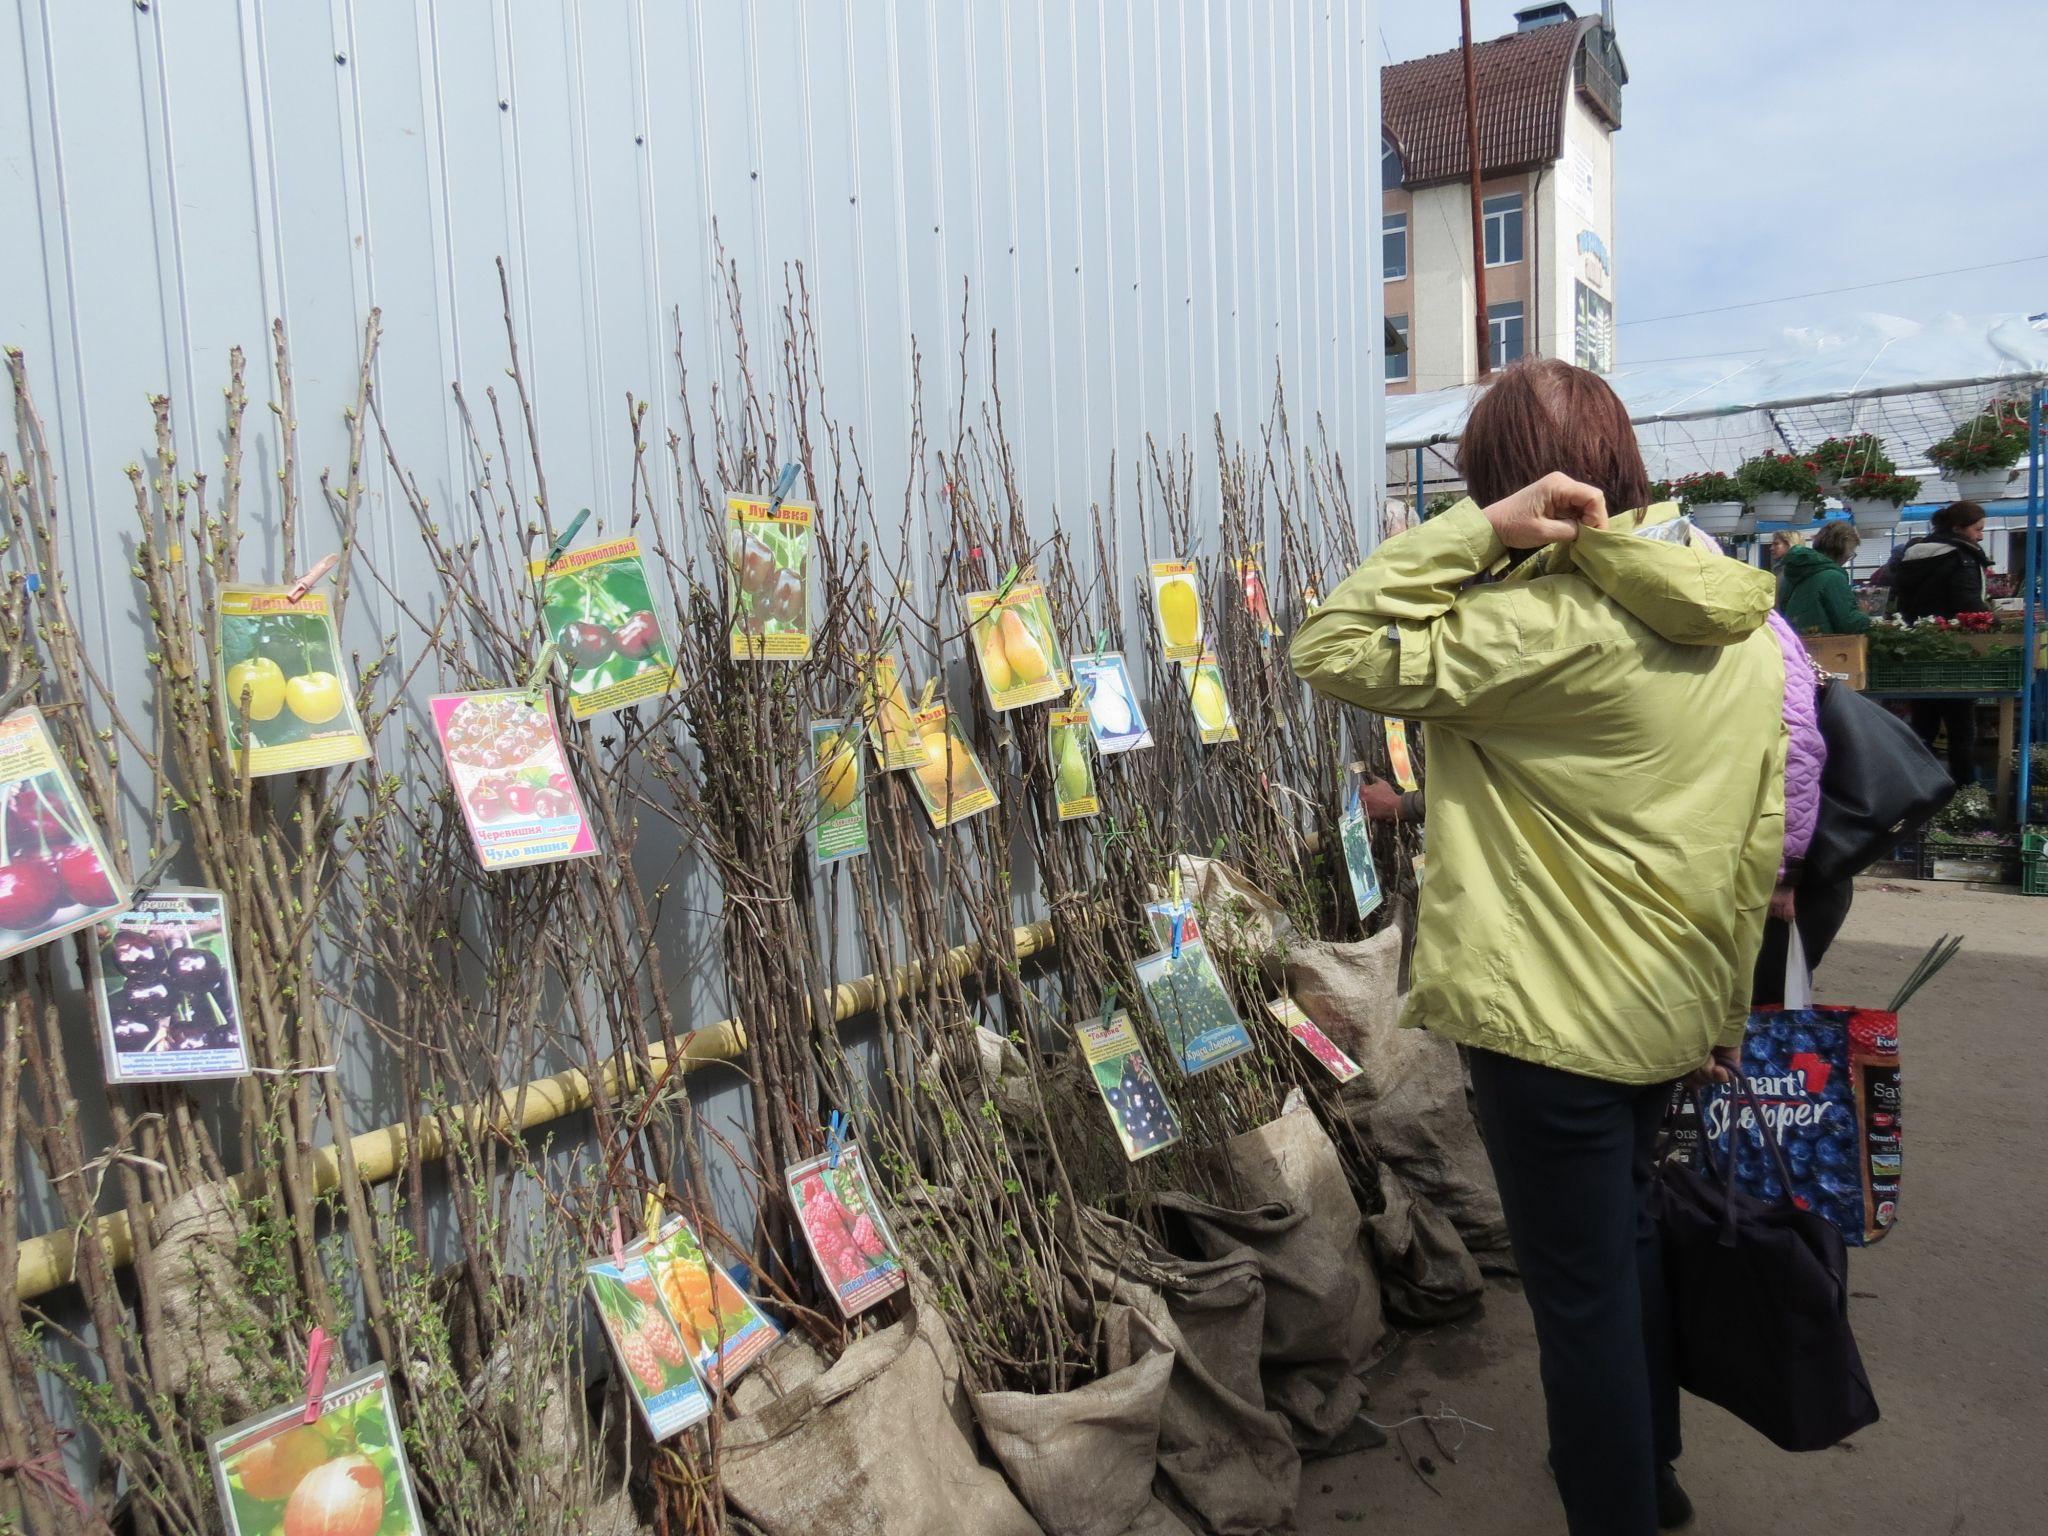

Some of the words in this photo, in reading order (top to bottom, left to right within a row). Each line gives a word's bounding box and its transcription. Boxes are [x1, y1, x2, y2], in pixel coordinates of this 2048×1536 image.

[478, 825, 542, 841] Черевишня
[485, 848, 520, 861] Чудо
[524, 841, 568, 856] вишня
[321, 1383, 375, 1414] Агрус
